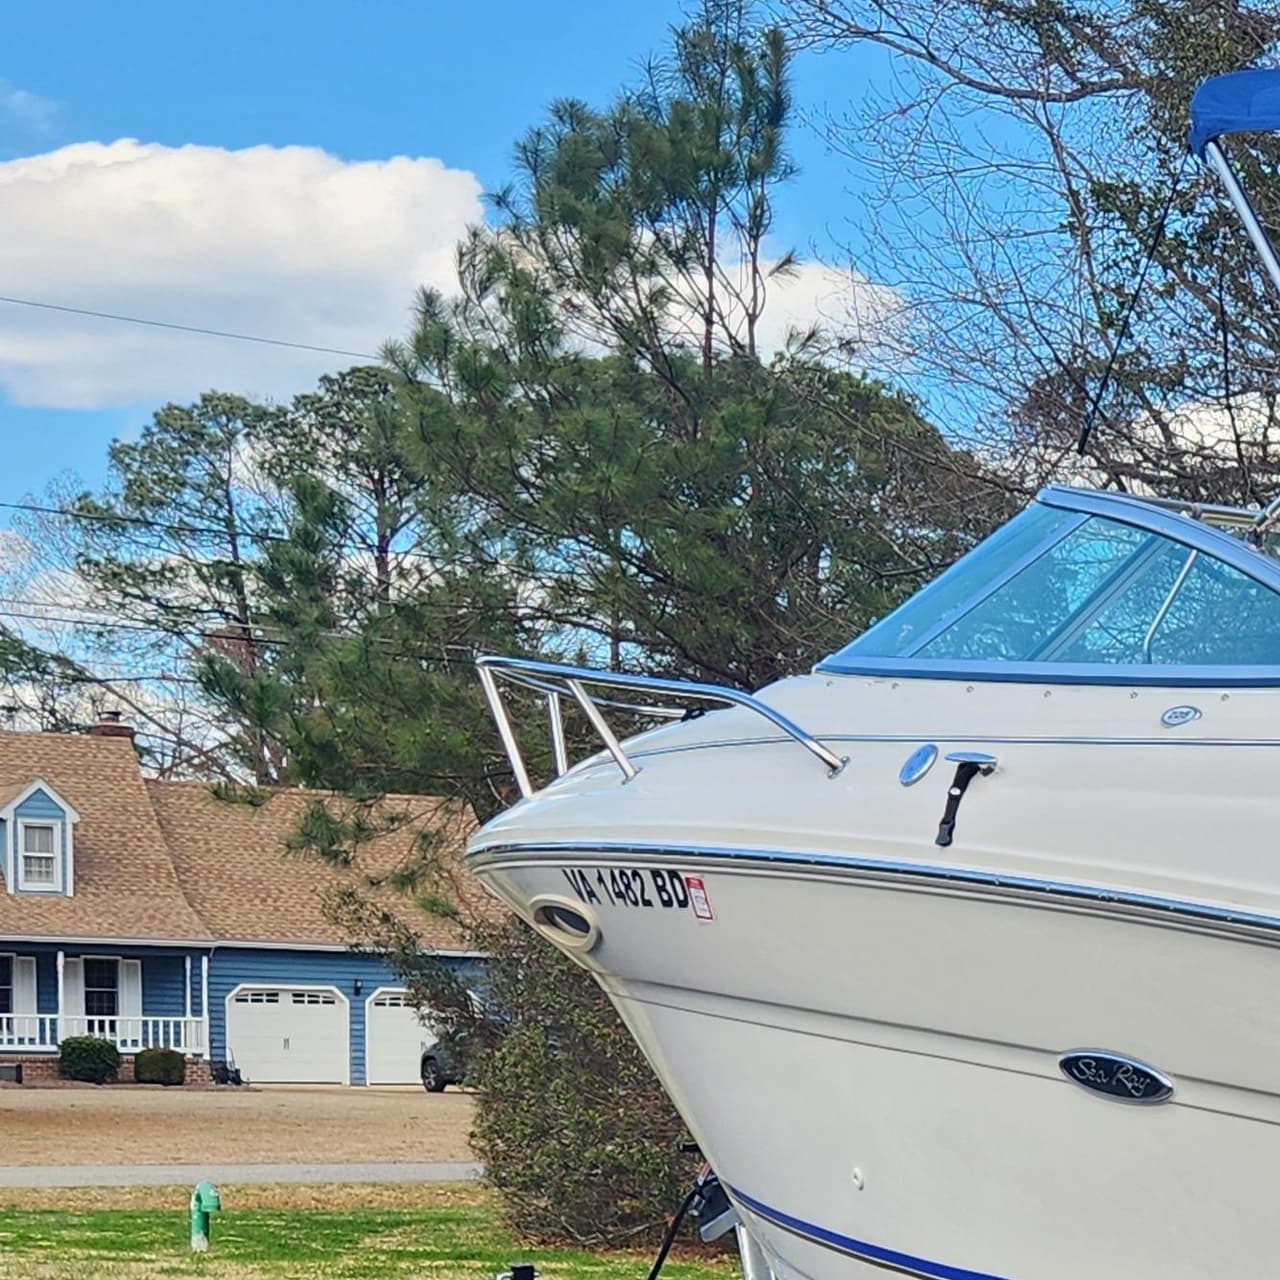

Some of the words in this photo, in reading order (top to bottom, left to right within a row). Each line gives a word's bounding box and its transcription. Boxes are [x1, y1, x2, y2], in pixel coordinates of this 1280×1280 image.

[562, 869, 601, 904] VA
[597, 869, 653, 907] 1482
[651, 870, 689, 908] BD
[1072, 1059, 1109, 1083] Sea
[1112, 1064, 1151, 1097] Ray
